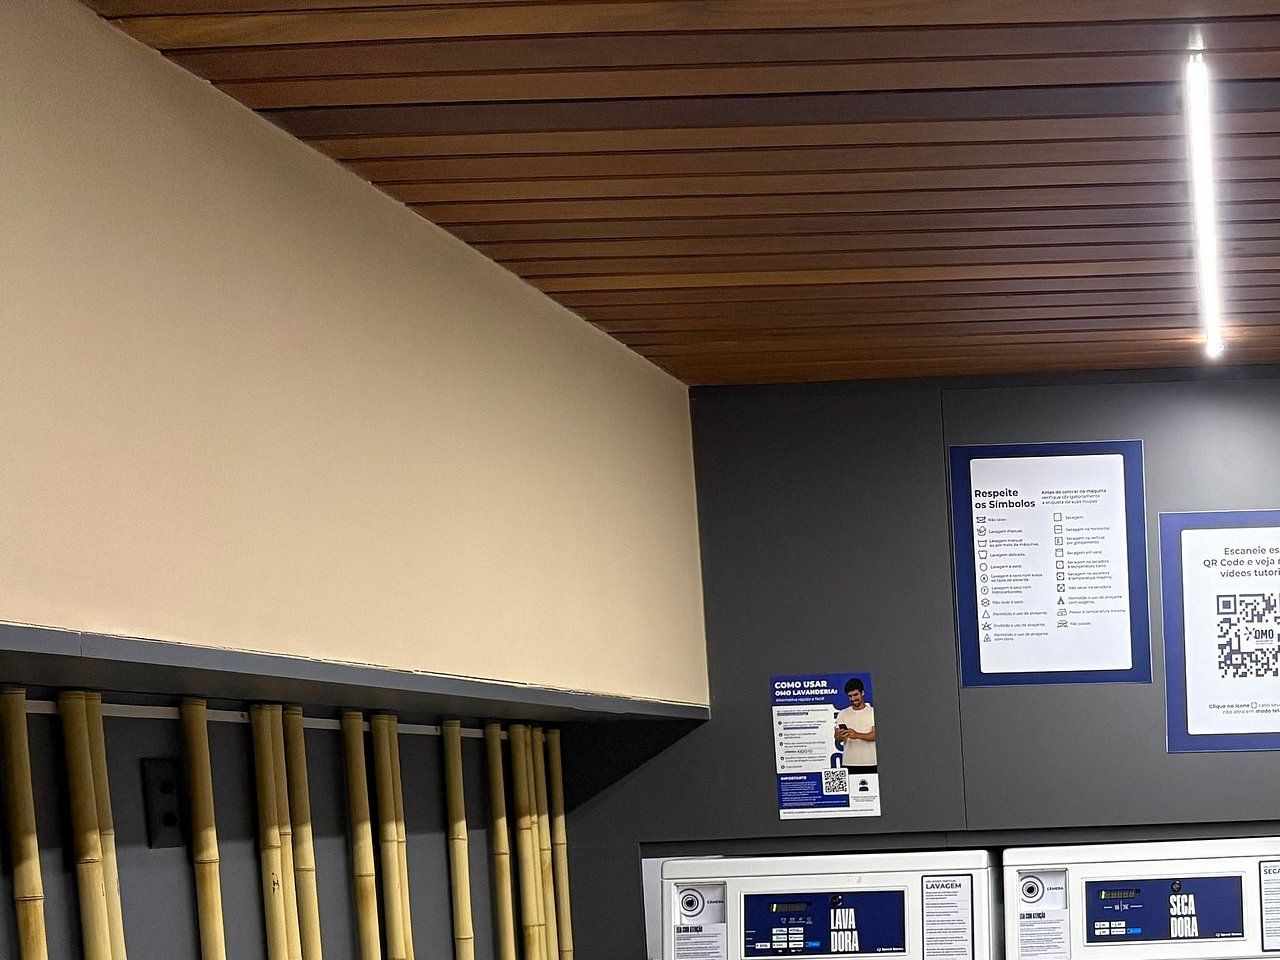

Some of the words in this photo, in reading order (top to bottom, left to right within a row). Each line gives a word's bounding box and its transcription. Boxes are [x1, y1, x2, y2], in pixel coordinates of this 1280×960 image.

[974, 488, 1018, 499] Respeite
[989, 500, 1036, 508] Símbolos
[1224, 546, 1266, 556] Escaneie
[1203, 557, 1217, 567] QR
[1220, 556, 1244, 566] Code
[1247, 558, 1253, 566] e
[1255, 556, 1275, 567] veja
[1254, 629, 1274, 640] OMO
[774, 681, 801, 689] COMO
[803, 680, 828, 688] USAR
[792, 688, 838, 696] LAVANDERIA:
[1169, 894, 1195, 916] SECA
[830, 908, 856, 930] LAVA
[1170, 916, 1199, 938] DORA
[830, 931, 859, 952] DORA
